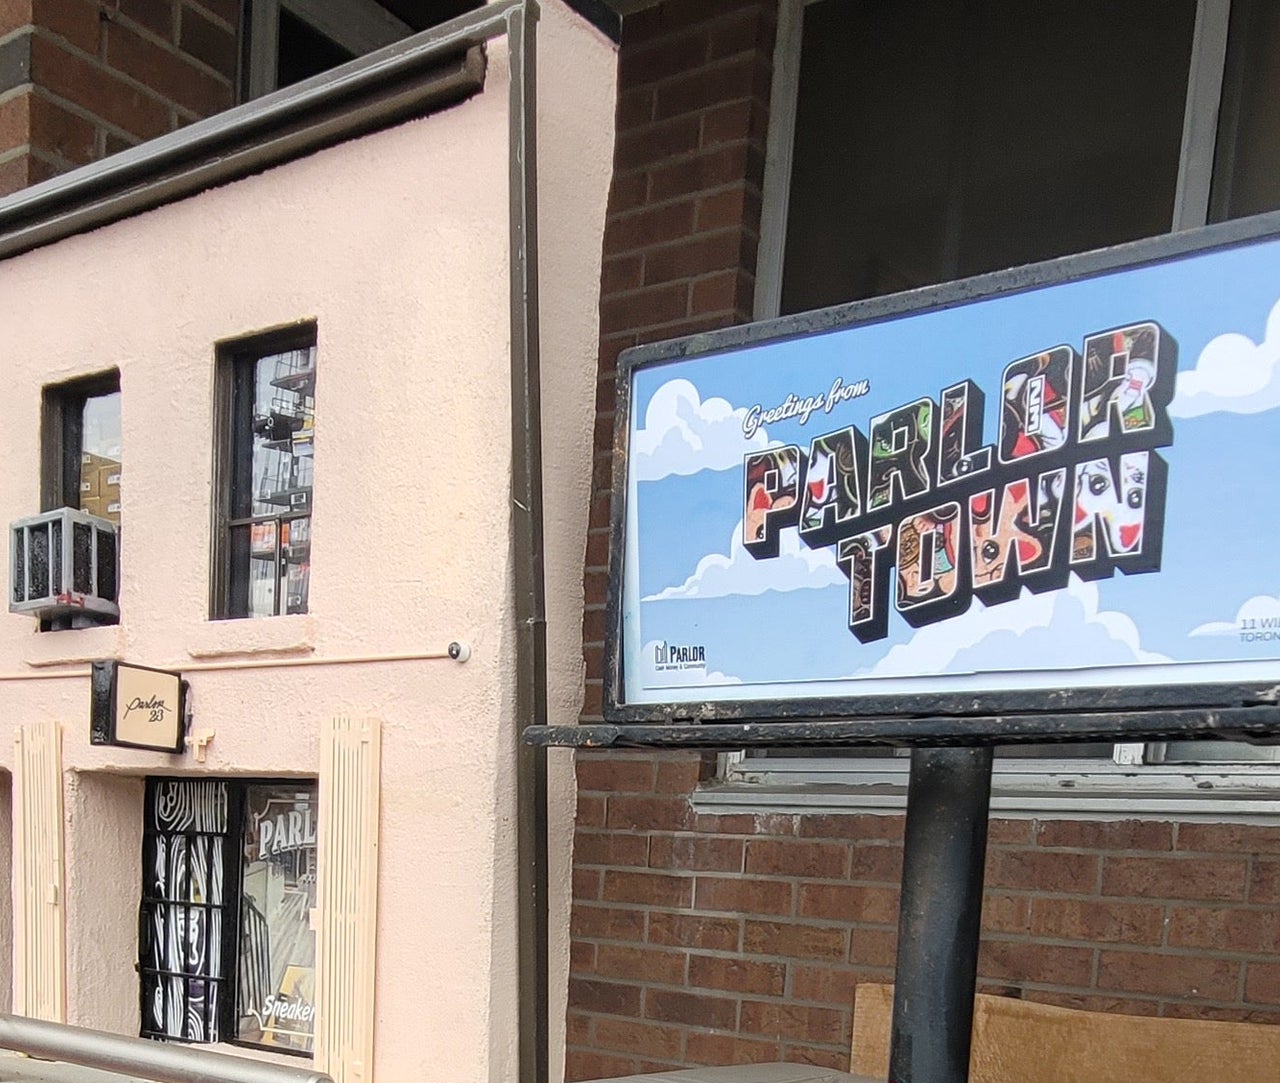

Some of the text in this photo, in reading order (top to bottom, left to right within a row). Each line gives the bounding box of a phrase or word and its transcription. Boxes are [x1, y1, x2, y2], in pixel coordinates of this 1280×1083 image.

[742, 376, 870, 439] Greetings from
[743, 319, 1179, 560] PARLOR
[836, 450, 1169, 643] TOWN
[1240, 619, 1257, 630] 11
[669, 645, 706, 663] PARLOR
[148, 710, 164, 723] 23
